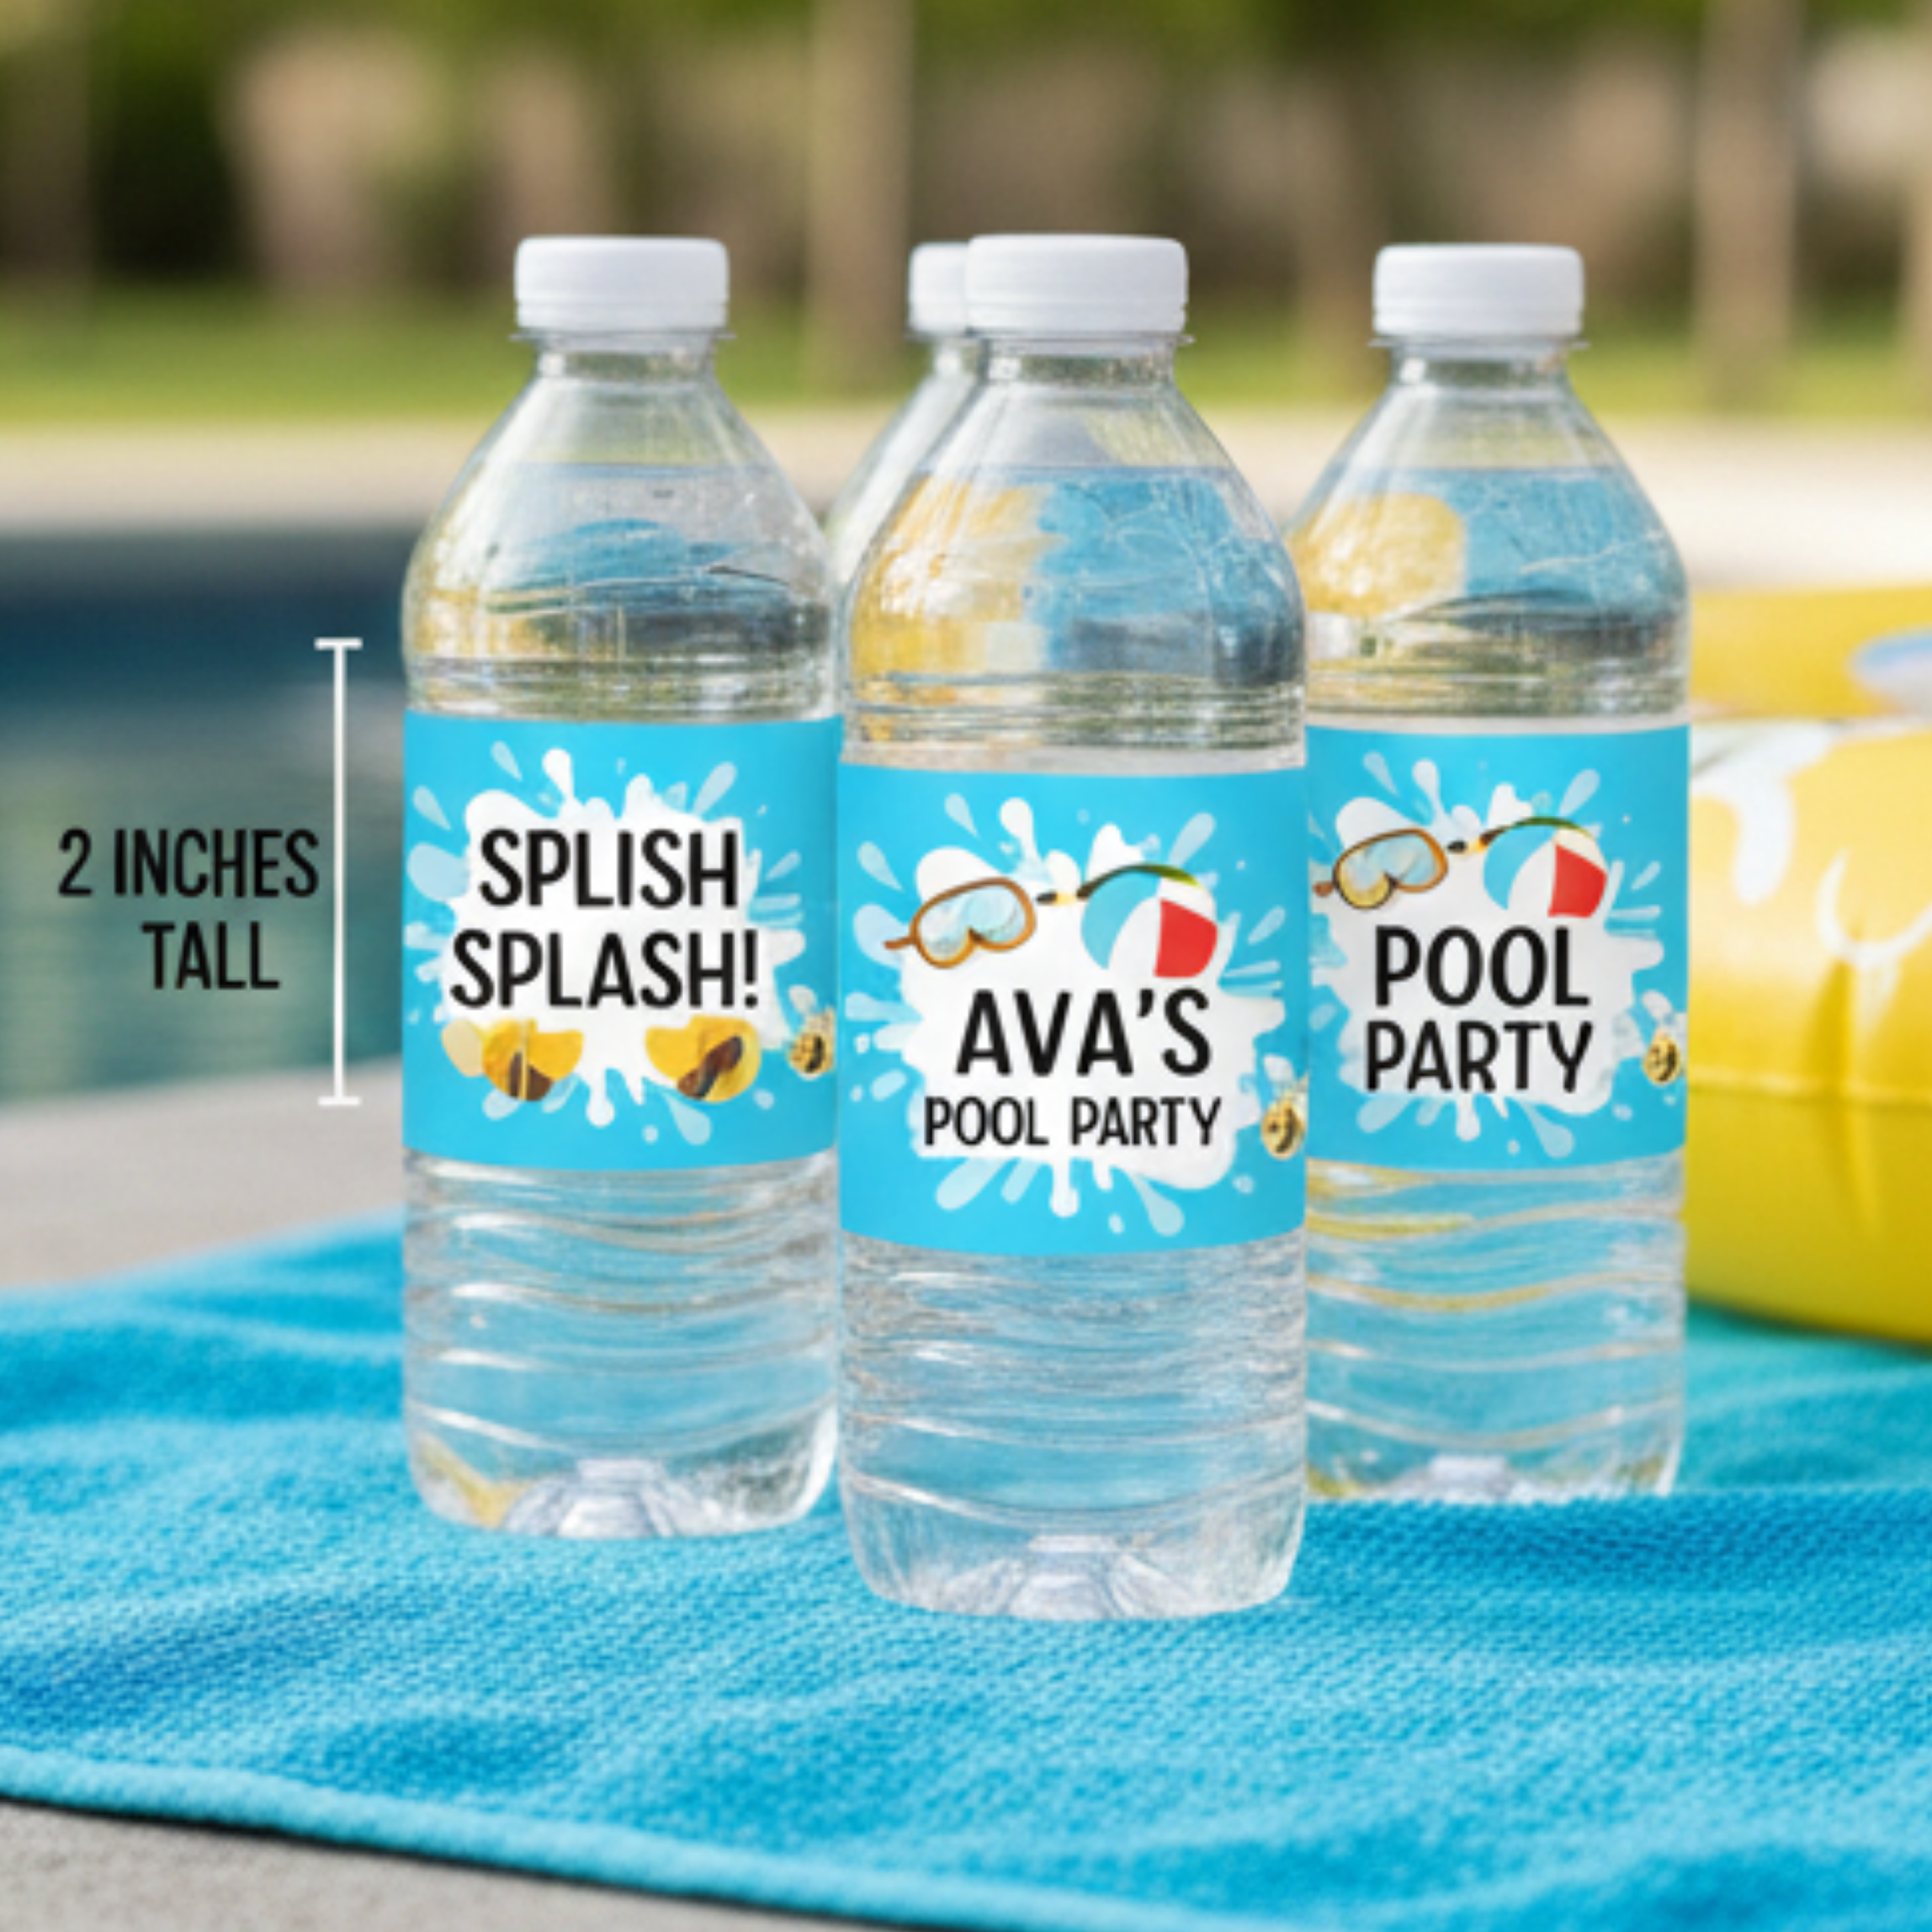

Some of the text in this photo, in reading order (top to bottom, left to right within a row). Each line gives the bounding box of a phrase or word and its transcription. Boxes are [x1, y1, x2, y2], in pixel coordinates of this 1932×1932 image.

[479, 828, 738, 909] SPLISH
[450, 928, 758, 1009] SPLASH!
[1374, 925, 1590, 1007] POOL
[956, 988, 1212, 1076] AVA'S
[1366, 1020, 1594, 1093] PARTY
[925, 1096, 1222, 1147] POOL PARTY
